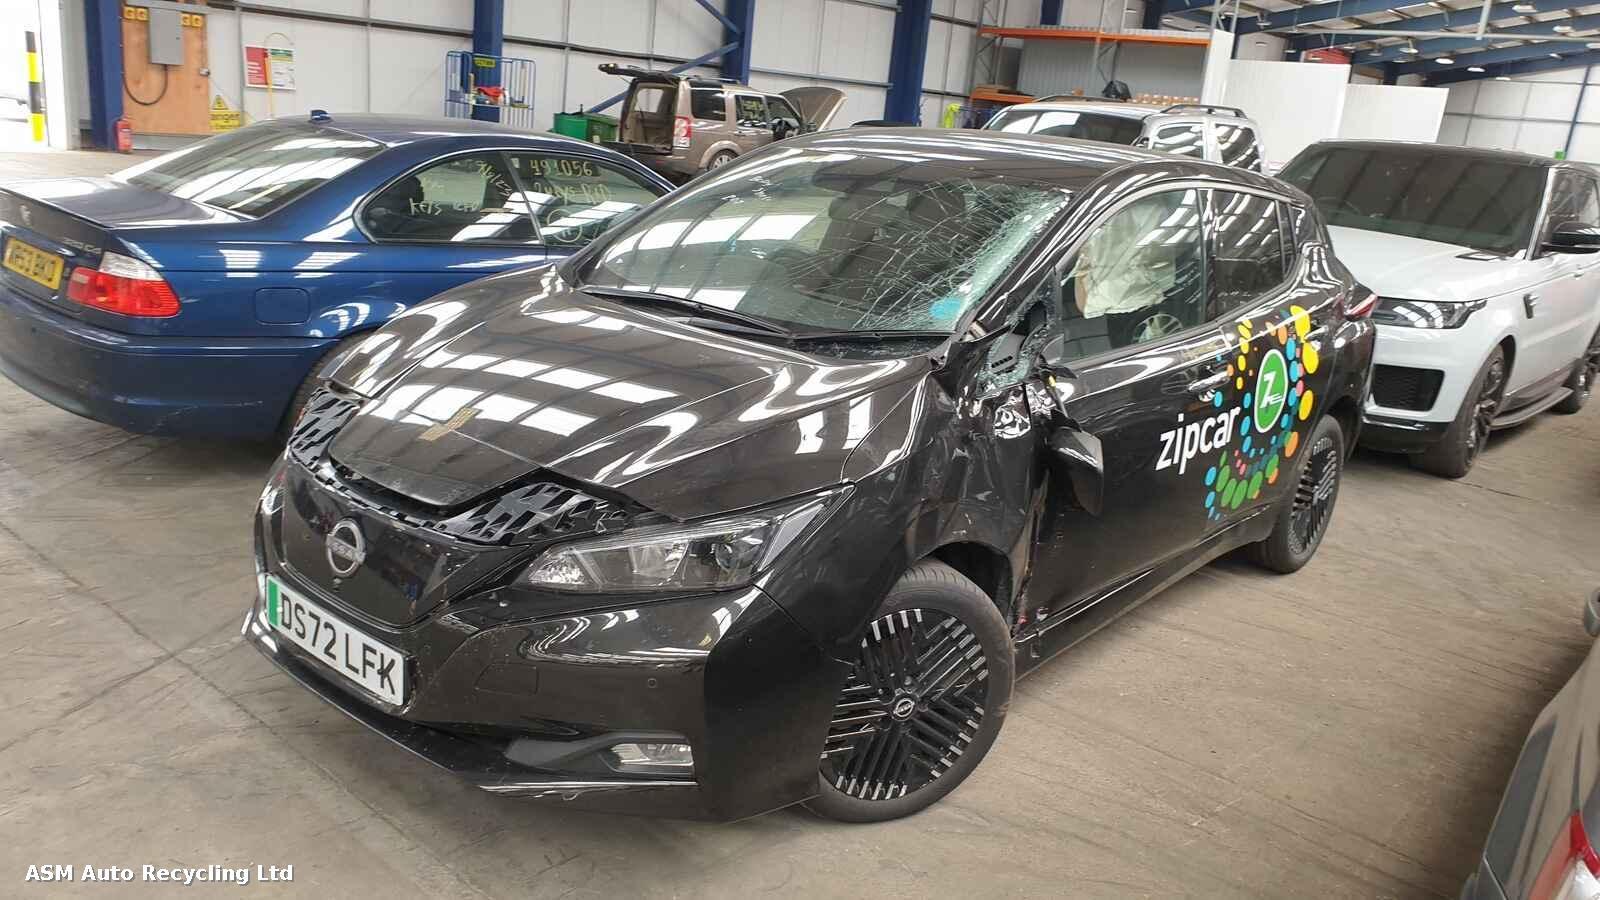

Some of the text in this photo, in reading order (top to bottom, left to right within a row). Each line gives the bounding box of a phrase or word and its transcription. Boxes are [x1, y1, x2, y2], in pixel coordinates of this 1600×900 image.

[1155, 406, 1241, 475] zipcar
[280, 592, 396, 696] DS72 LFK
